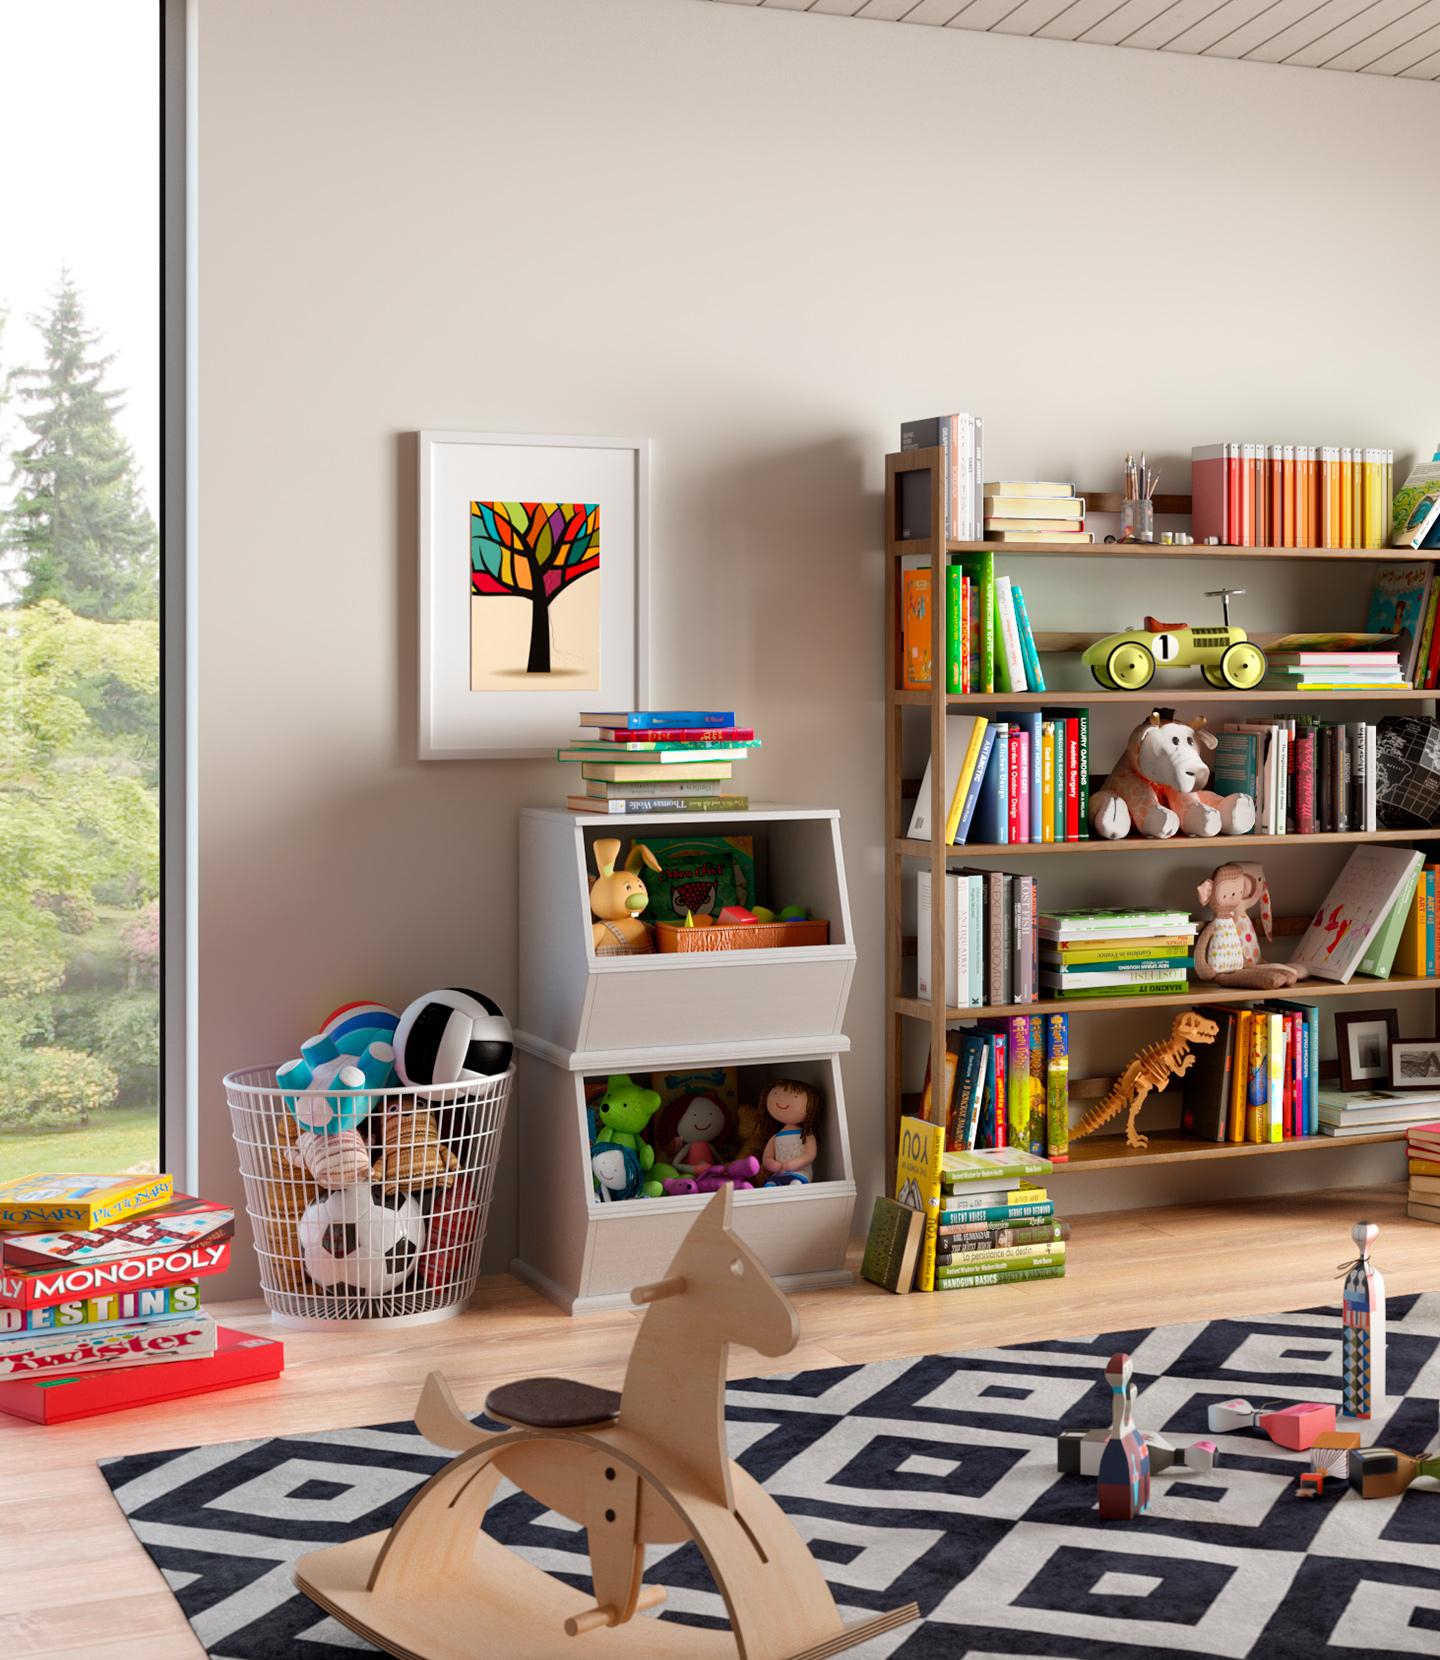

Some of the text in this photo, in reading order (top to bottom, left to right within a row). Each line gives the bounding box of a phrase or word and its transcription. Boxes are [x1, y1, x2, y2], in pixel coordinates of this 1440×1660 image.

[1159, 634, 1169, 660] 1
[974, 739, 991, 782] ANTARCTIC
[998, 774, 1006, 799] Design
[1069, 769, 1077, 798] Surgery
[628, 800, 687, 811] Thomas Wolfe
[1009, 798, 1018, 819] Design
[1021, 879, 1031, 935] LOST FISH
[1149, 984, 1183, 992] MAKING
[902, 1129, 929, 1166] YOU
[92, 1182, 171, 1223] PICTIONARY
[926, 1217, 936, 1241] YOU
[950, 1211, 968, 1224] SILENT
[33, 1244, 227, 1300] MONOPOLY
[943, 1273, 998, 1289] HANDGUN BASICS
[0, 1286, 198, 1333] DESTINS
